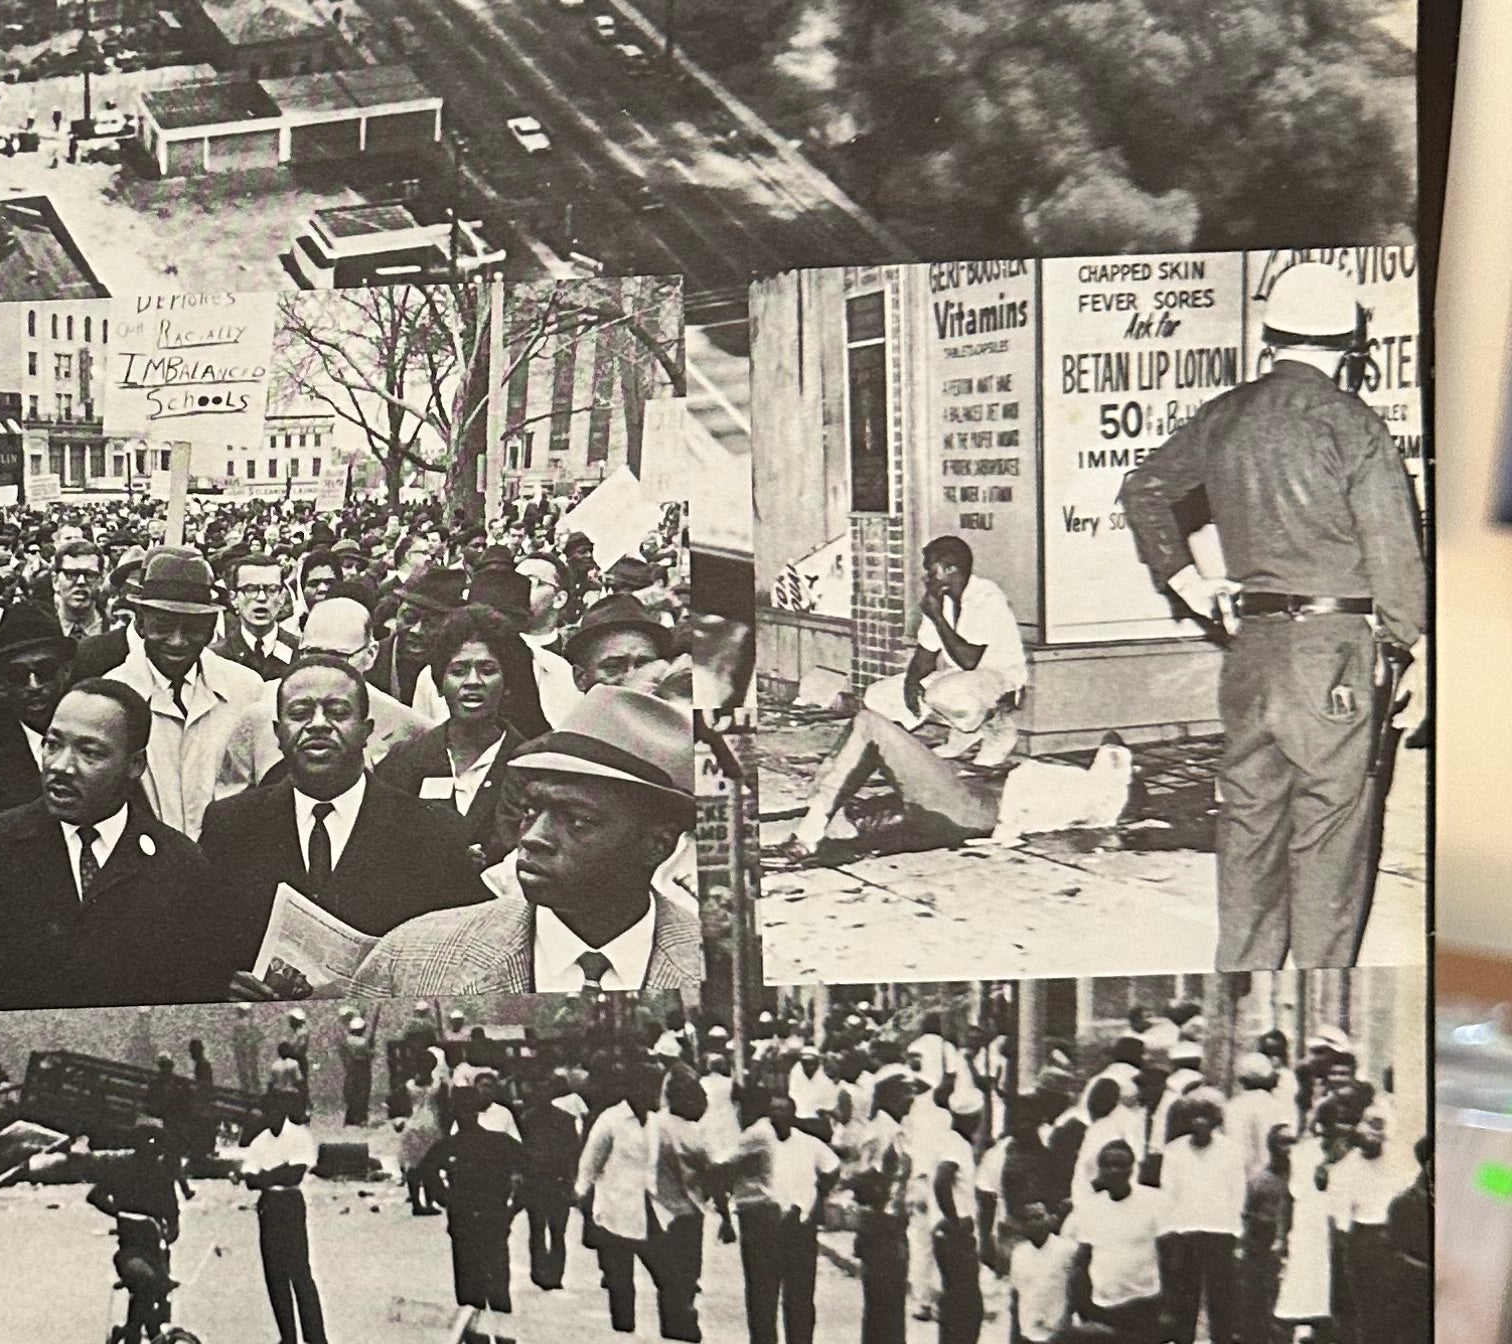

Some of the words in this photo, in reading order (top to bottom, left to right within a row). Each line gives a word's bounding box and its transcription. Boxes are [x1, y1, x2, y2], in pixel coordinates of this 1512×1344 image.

[1078, 262, 1152, 283] CHAPPED
[1158, 260, 1205, 281] SKIN
[1078, 292, 1138, 313] FEVER
[1154, 288, 1215, 310] SORES
[933, 291, 1028, 340] Vitamins
[1062, 352, 1130, 394] BETAN
[1138, 350, 1170, 391] LIP
[1175, 346, 1238, 389] LOTION
[1078, 447, 1160, 469] IMME
[1062, 504, 1101, 537] Very
